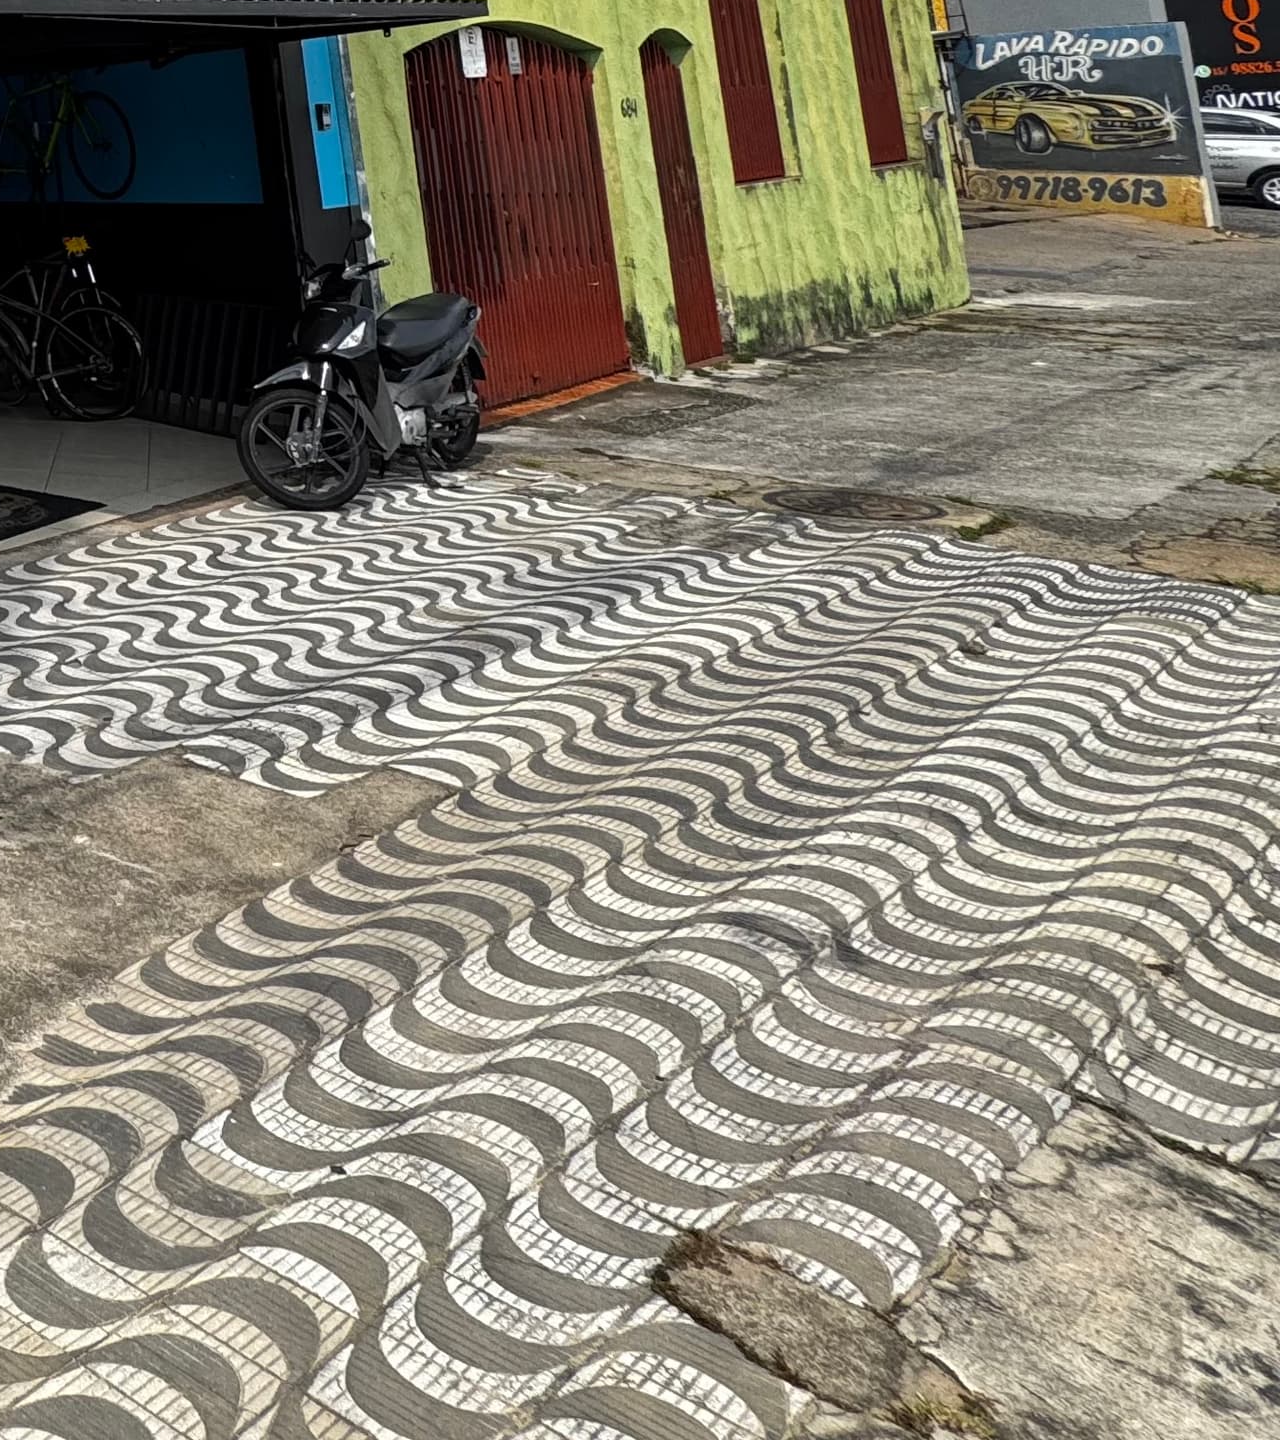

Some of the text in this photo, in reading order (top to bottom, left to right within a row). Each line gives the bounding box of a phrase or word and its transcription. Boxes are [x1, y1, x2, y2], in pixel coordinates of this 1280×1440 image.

[975, 30, 1164, 71] LAVA RÁPIDO
[620, 96, 638, 118] 684
[996, 175, 1168, 208] 99718-9613
